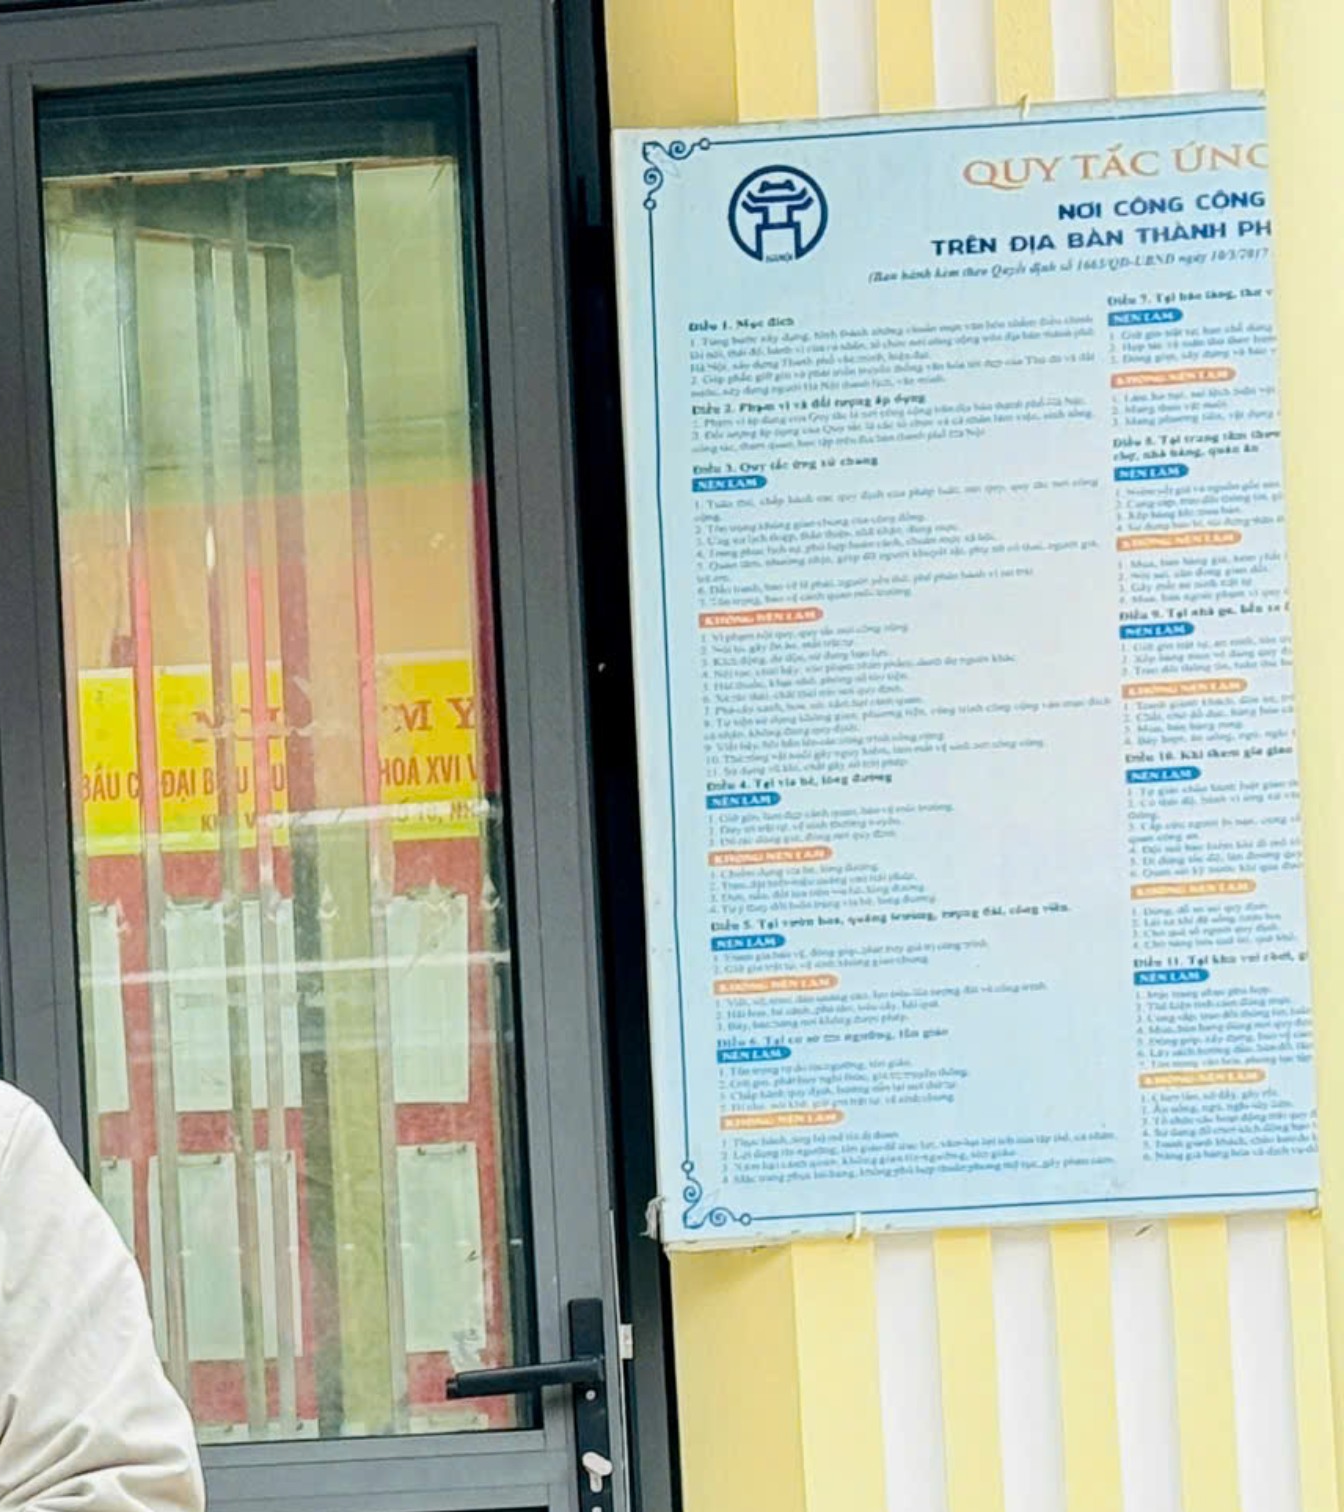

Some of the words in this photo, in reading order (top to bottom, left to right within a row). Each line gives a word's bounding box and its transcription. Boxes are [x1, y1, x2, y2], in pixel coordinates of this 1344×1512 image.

[963, 156, 1061, 190] QUY
[1071, 143, 1159, 180] TẮC
[1058, 201, 1102, 221] NƠI
[1114, 195, 1183, 217] CÔNG
[931, 235, 996, 256] TRÊN
[1010, 235, 1055, 256] ĐỊA
[1067, 228, 1123, 249] BÀN
[1135, 221, 1226, 245] THÀNH
[1238, 220, 1272, 237] PH
